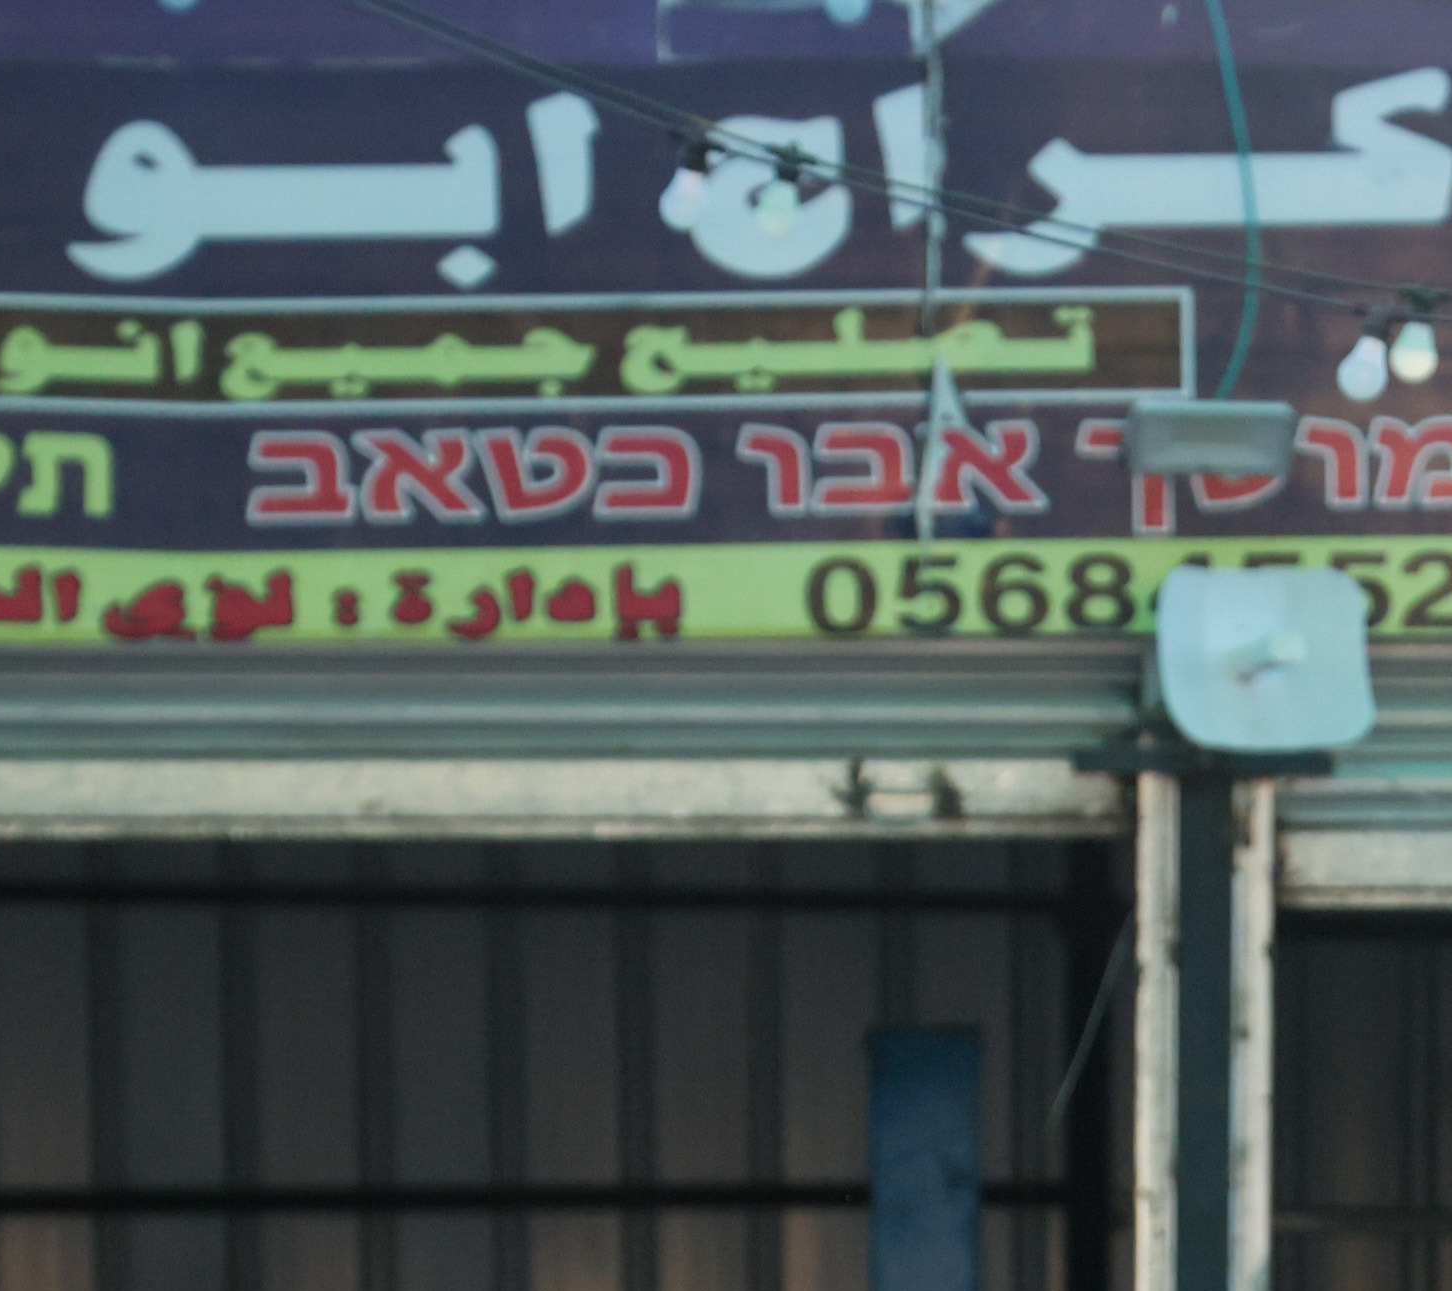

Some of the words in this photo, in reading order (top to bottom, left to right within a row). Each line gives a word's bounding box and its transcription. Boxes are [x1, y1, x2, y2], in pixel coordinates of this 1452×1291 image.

[67, 91, 601, 290] ابو
[248, 426, 702, 524] כטאב
[738, 424, 1050, 516] אבו
